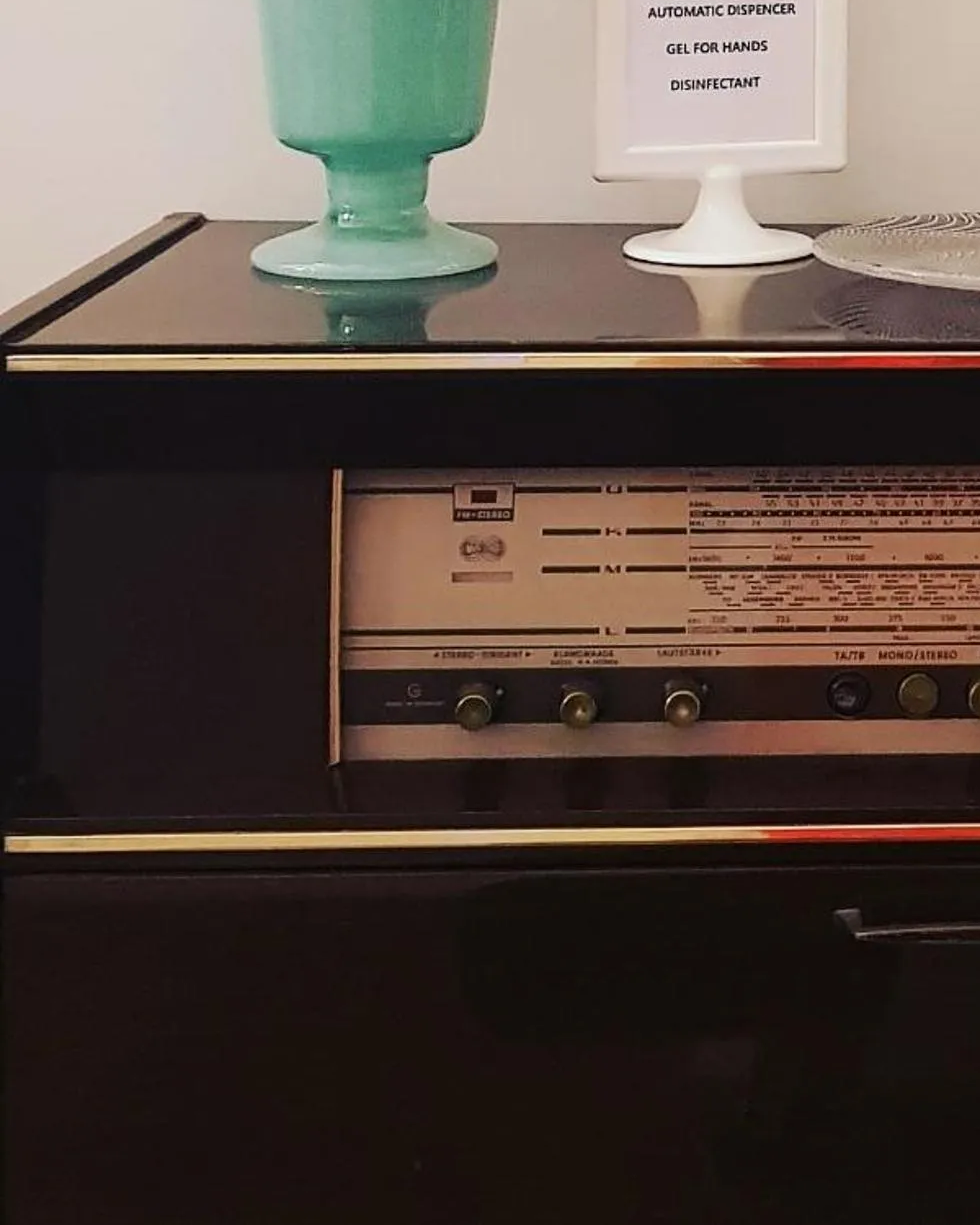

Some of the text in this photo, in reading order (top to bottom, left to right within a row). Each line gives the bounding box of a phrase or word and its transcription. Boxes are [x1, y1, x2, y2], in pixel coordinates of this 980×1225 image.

[647, 2, 796, 19] AUTOMATIC DISPENCER
[666, 39, 769, 55] GEL FOR HANDS
[670, 76, 761, 92] DISINFECTANT
[877, 649, 958, 660] MONO/STEREO
